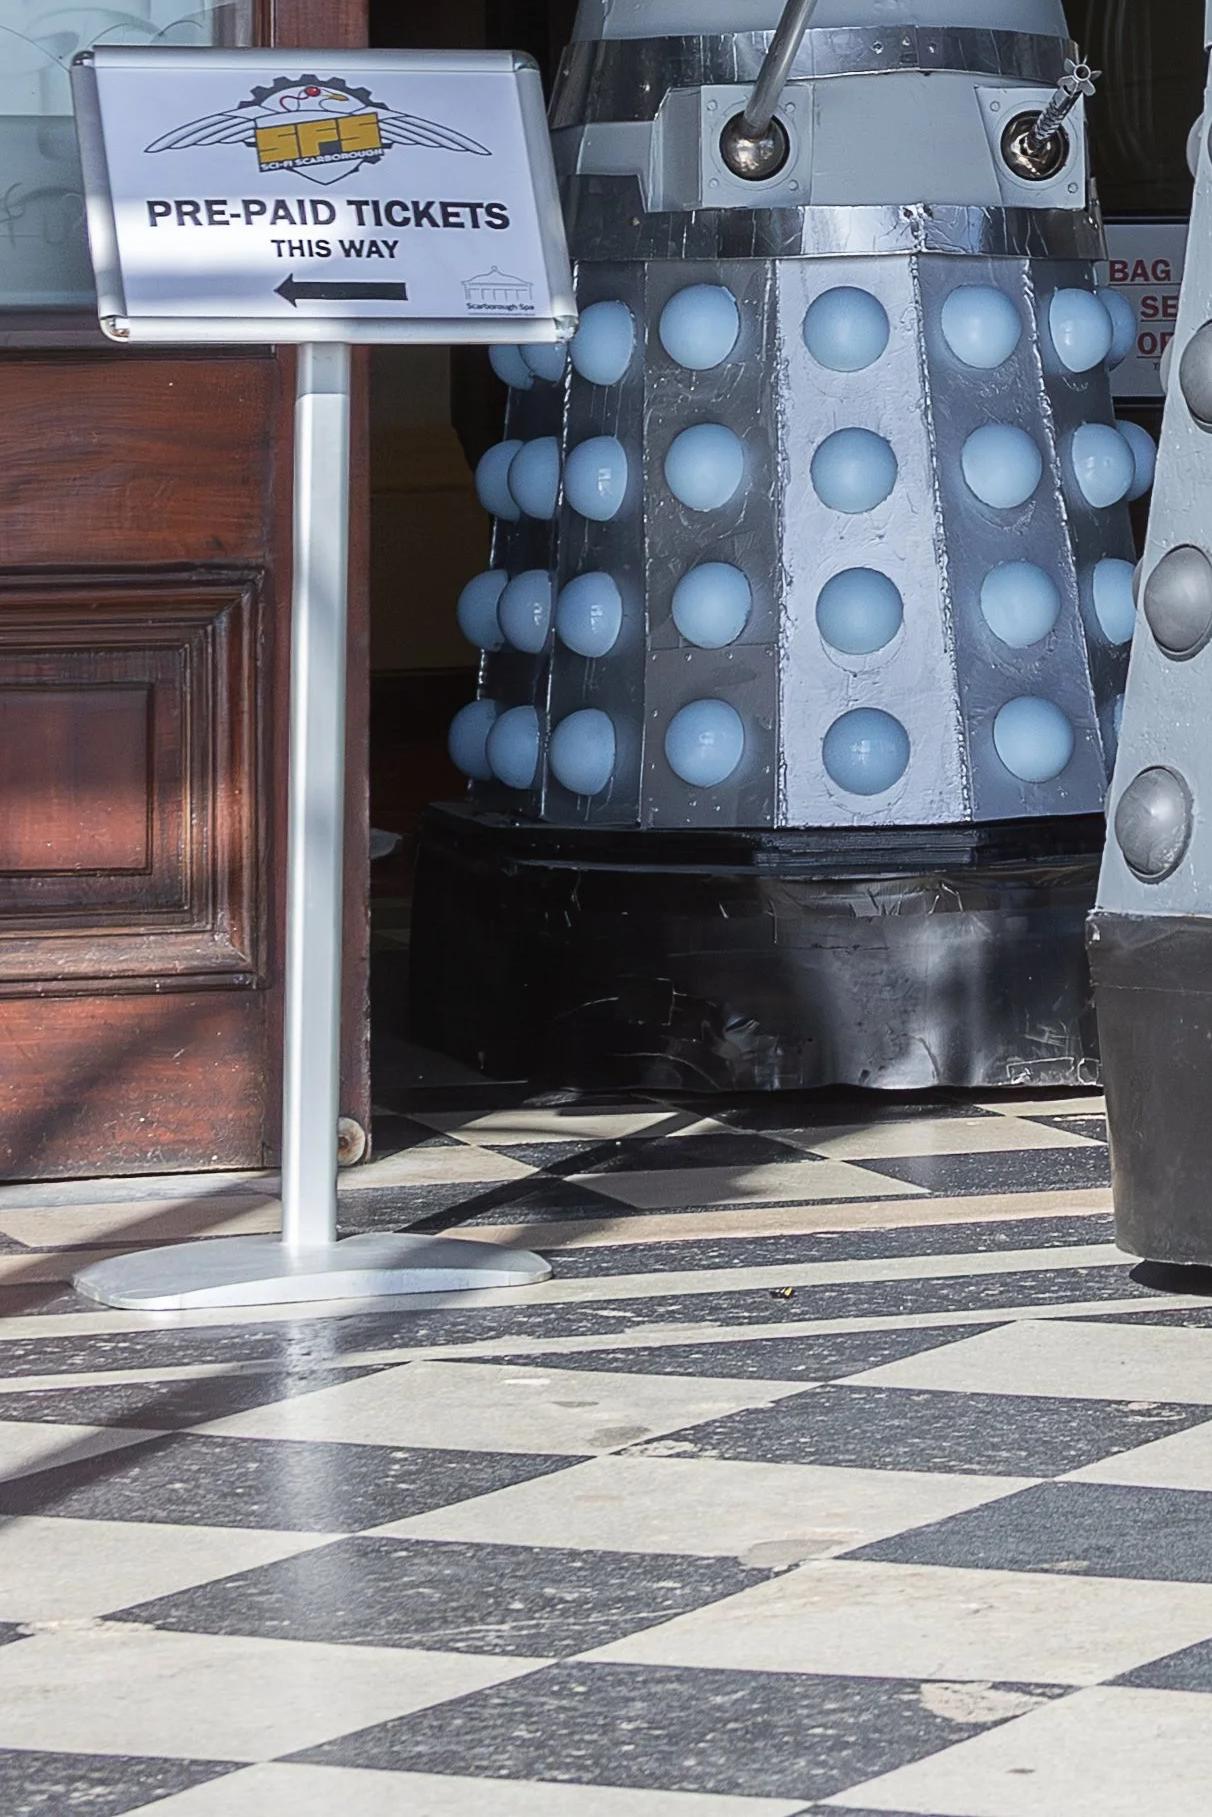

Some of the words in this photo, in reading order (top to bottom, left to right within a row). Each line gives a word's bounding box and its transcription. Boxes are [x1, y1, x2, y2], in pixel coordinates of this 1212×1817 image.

[255, 113, 381, 163] SFS
[260, 160, 293, 171] SCI-FI
[294, 148, 383, 167] SCARBOROUGH
[146, 199, 336, 228] PRE-PAID
[347, 200, 511, 230] TICKETS
[271, 239, 331, 259] THIS
[338, 239, 400, 259] WAY
[1109, 259, 1170, 283] BAG
[466, 302, 518, 312] Scarborough
